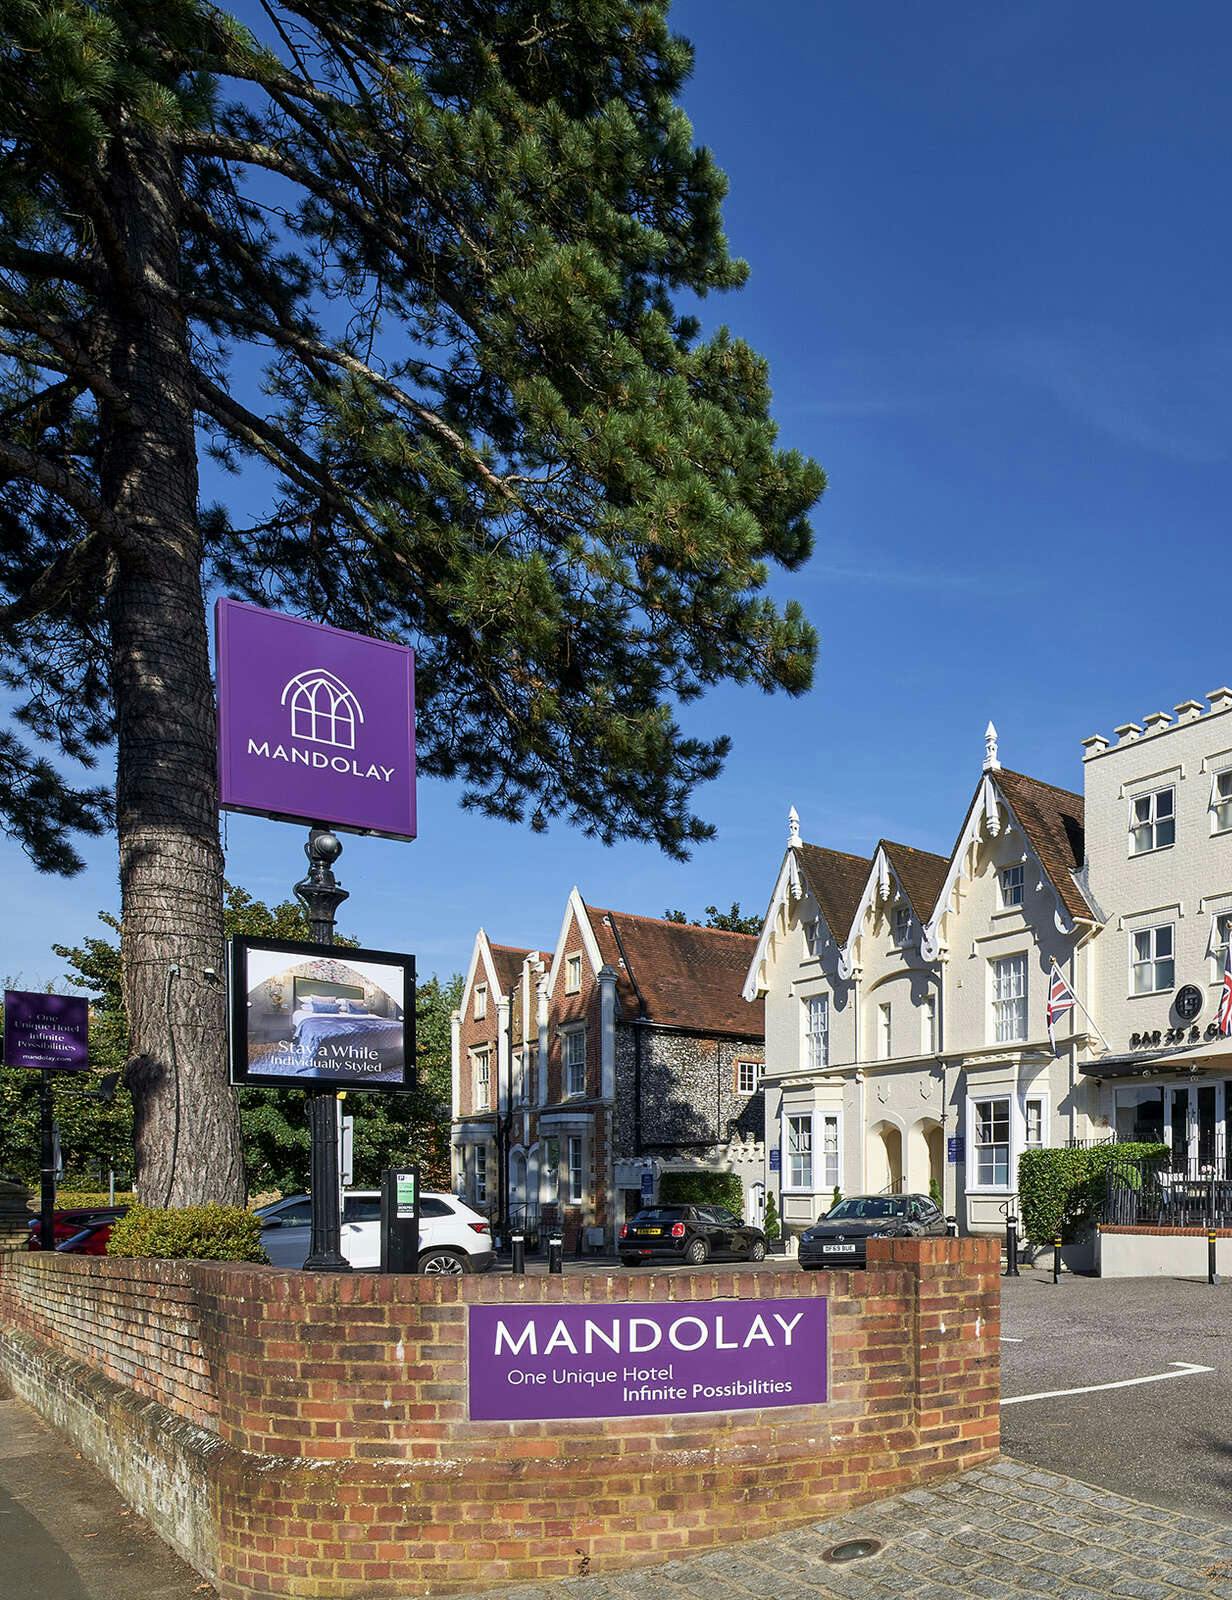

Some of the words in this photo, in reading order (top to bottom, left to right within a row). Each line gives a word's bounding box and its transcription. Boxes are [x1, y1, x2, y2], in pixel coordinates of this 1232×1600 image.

[247, 738, 395, 782] MANDOLAY
[17, 1040, 77, 1051] Possibilities
[29, 1032, 65, 1042] Infinite
[1131, 1030, 1161, 1045] BAR
[22, 1054, 72, 1062] mandolay.com
[278, 1040, 315, 1058] Stay
[318, 1046, 328, 1057] a
[330, 1045, 379, 1060] While
[271, 1055, 343, 1072] Individually
[344, 1060, 382, 1073] Styled
[494, 1312, 805, 1356] MANDOLAY
[507, 1369, 547, 1386] One
[552, 1367, 617, 1388] Unique
[623, 1364, 674, 1383] Hotel
[623, 1385, 688, 1402] Infinite
[692, 1379, 793, 1399] Possibilities
